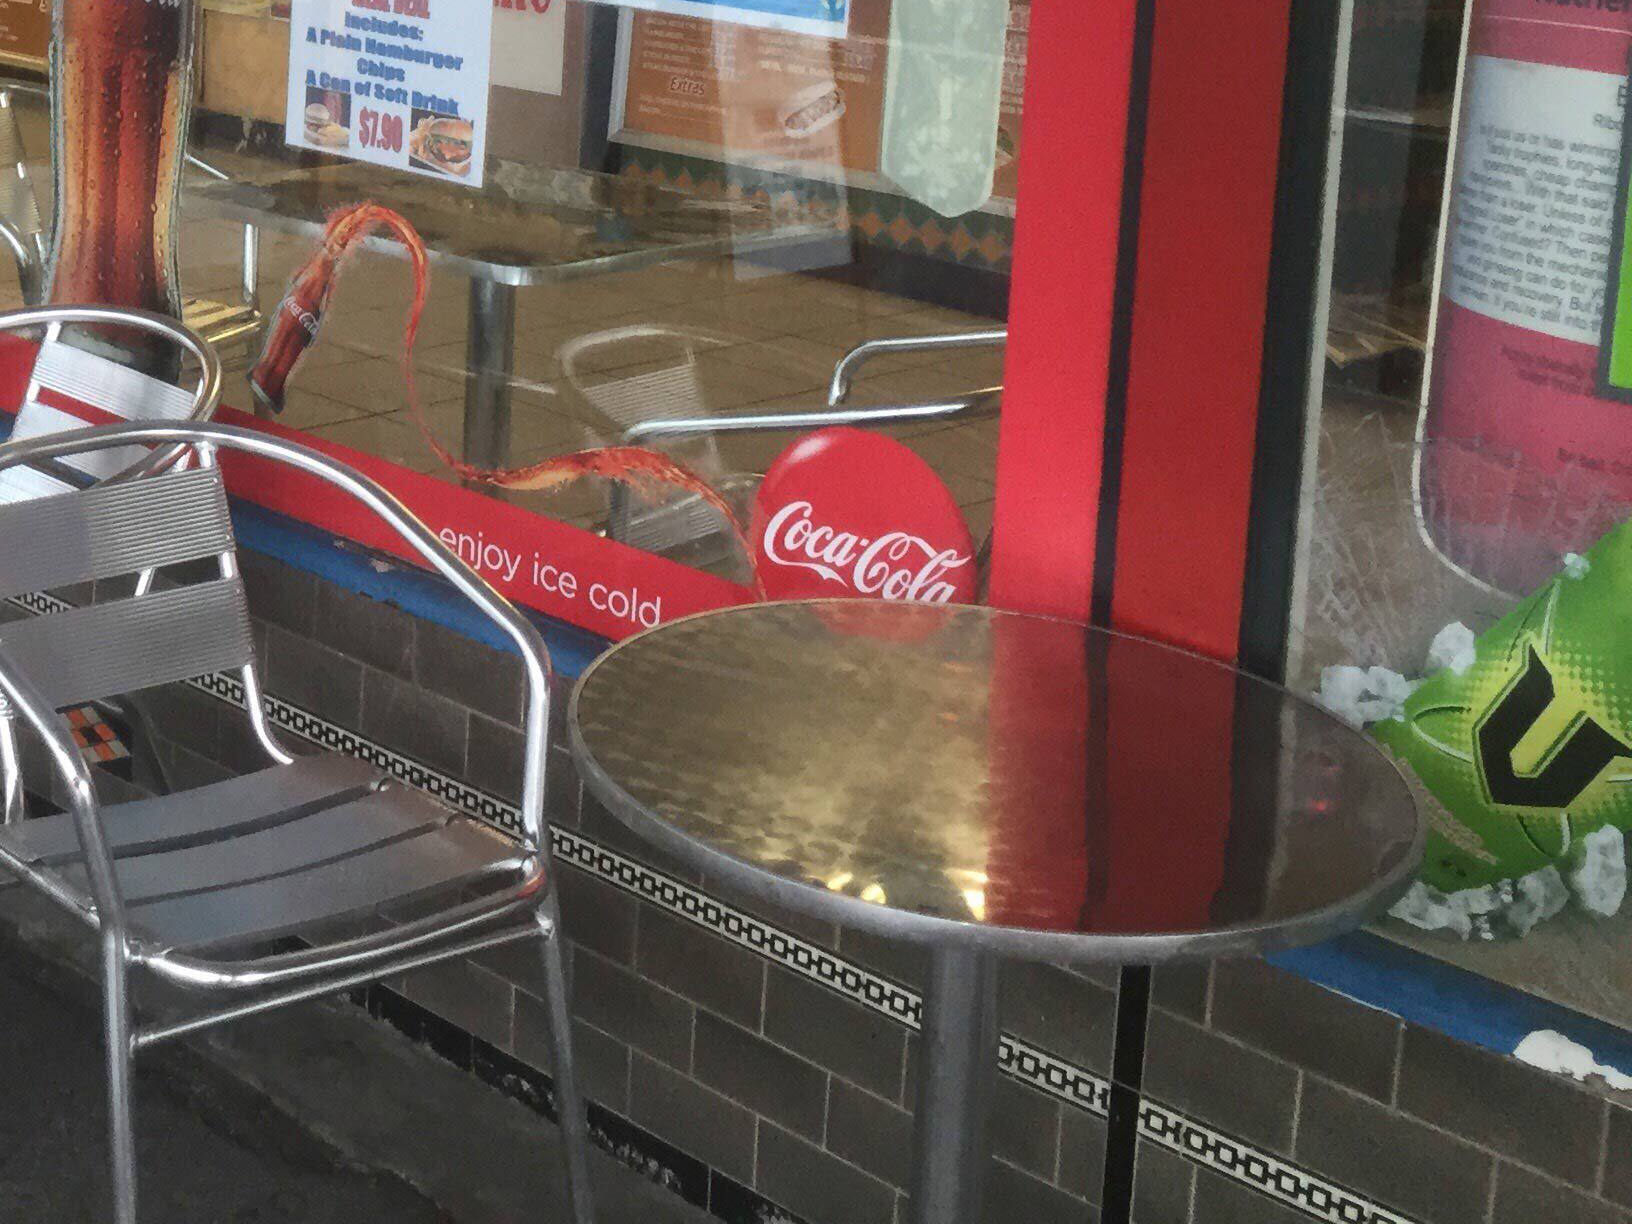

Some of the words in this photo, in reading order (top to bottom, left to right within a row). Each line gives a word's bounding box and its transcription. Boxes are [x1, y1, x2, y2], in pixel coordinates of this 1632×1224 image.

[306, 26, 317, 44] A
[320, 28, 362, 52] Plain
[365, 37, 464, 71] Hamburger
[344, 11, 424, 41] Includes:
[305, 69, 317, 87] A
[319, 72, 351, 93] Can
[354, 81, 372, 97] of
[374, 83, 409, 105] Soft
[411, 90, 459, 115] Drink
[356, 57, 406, 83] Chips
[669, 77, 705, 96] Extras
[358, 106, 404, 153] $7.90
[1526, 251, 1545, 269] the
[764, 501, 972, 604] Coca-Cola
[439, 528, 522, 582] enjoy
[533, 552, 578, 600] ice
[589, 587, 662, 628] cold
